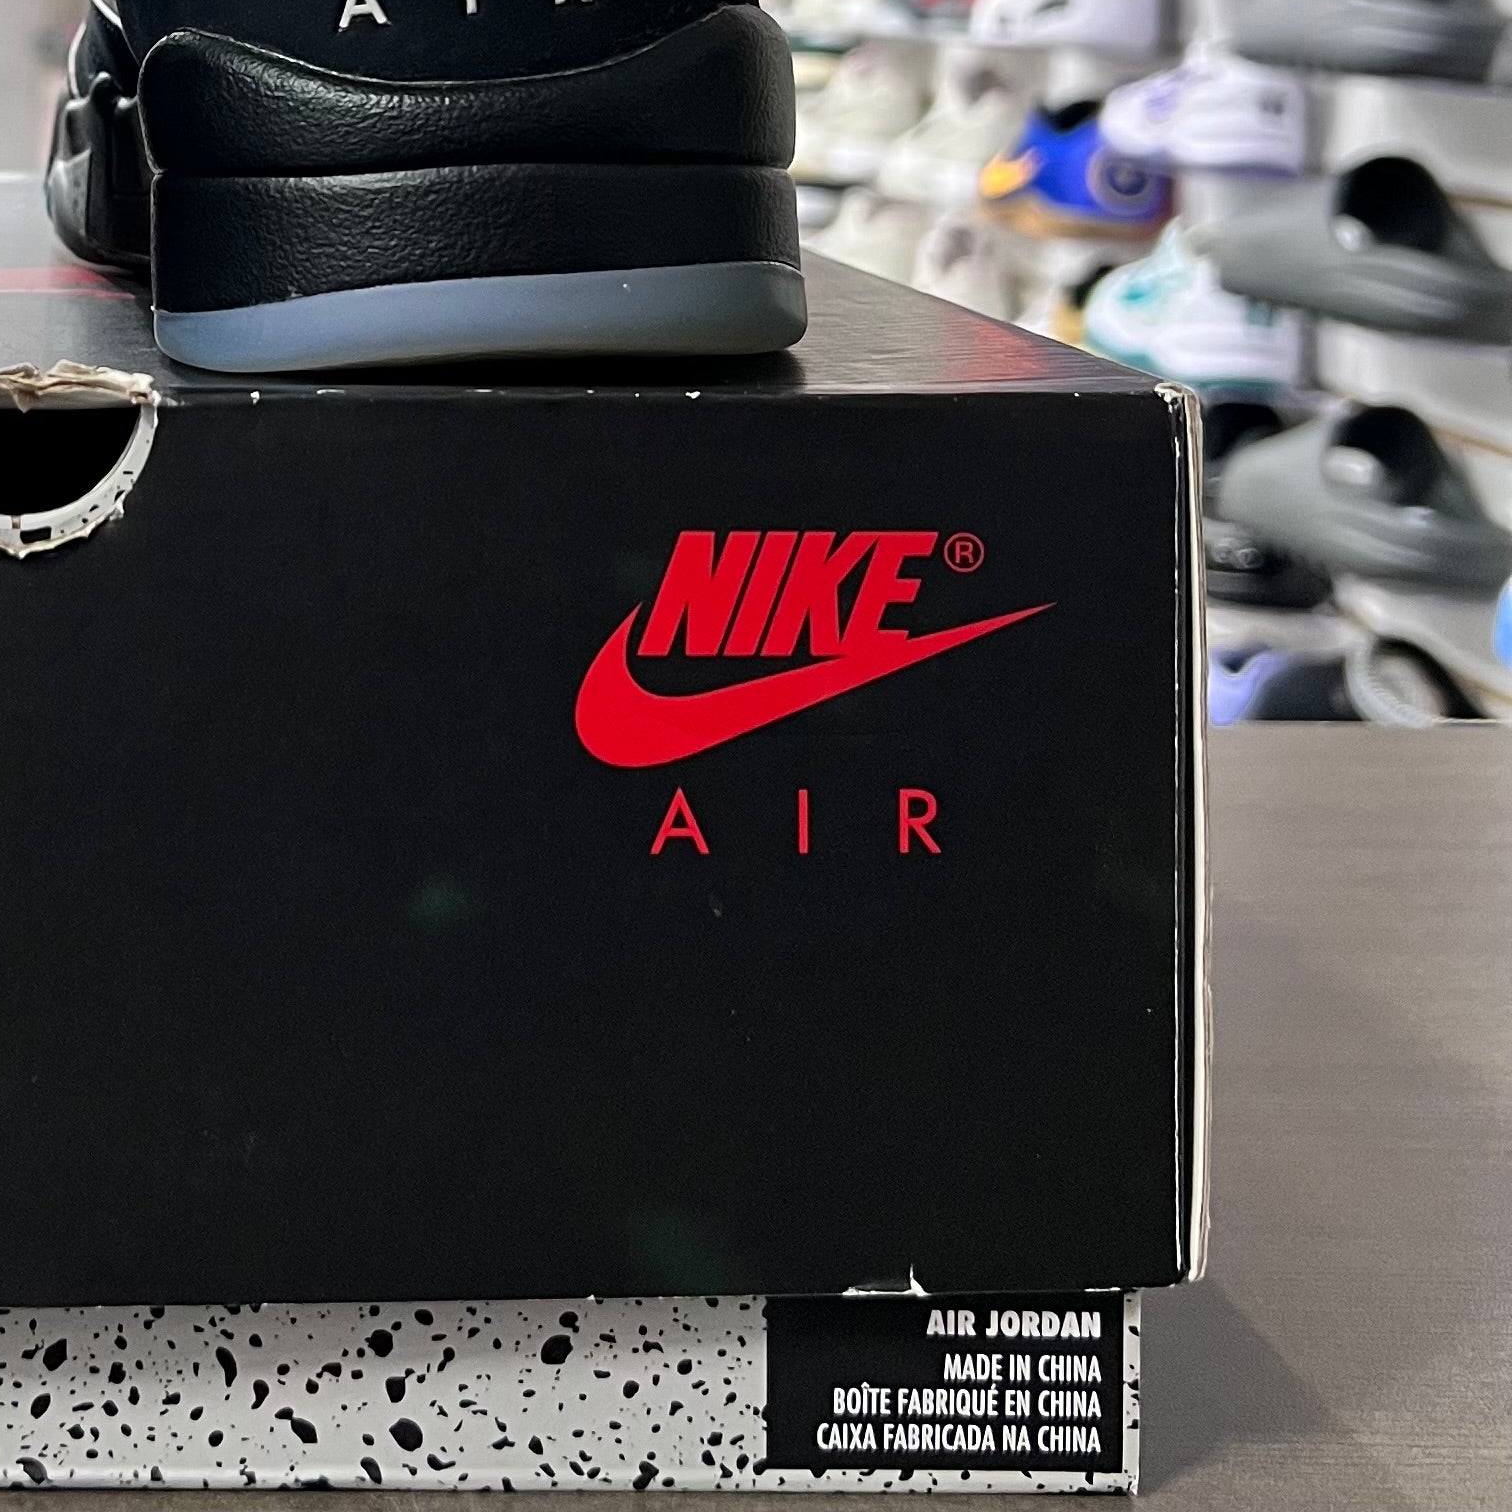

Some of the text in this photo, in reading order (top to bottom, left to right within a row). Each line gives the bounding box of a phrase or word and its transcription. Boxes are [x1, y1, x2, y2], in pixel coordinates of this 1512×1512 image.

[926, 1309, 1102, 1339] AIR JORDAN
[943, 1353, 1102, 1383] MADE IN CHINA
[833, 1382, 1102, 1418] BOÎTE FABRIQUÉ EN CHINA
[816, 1422, 1102, 1453] CAIXA FABRICADA NA CHINA
